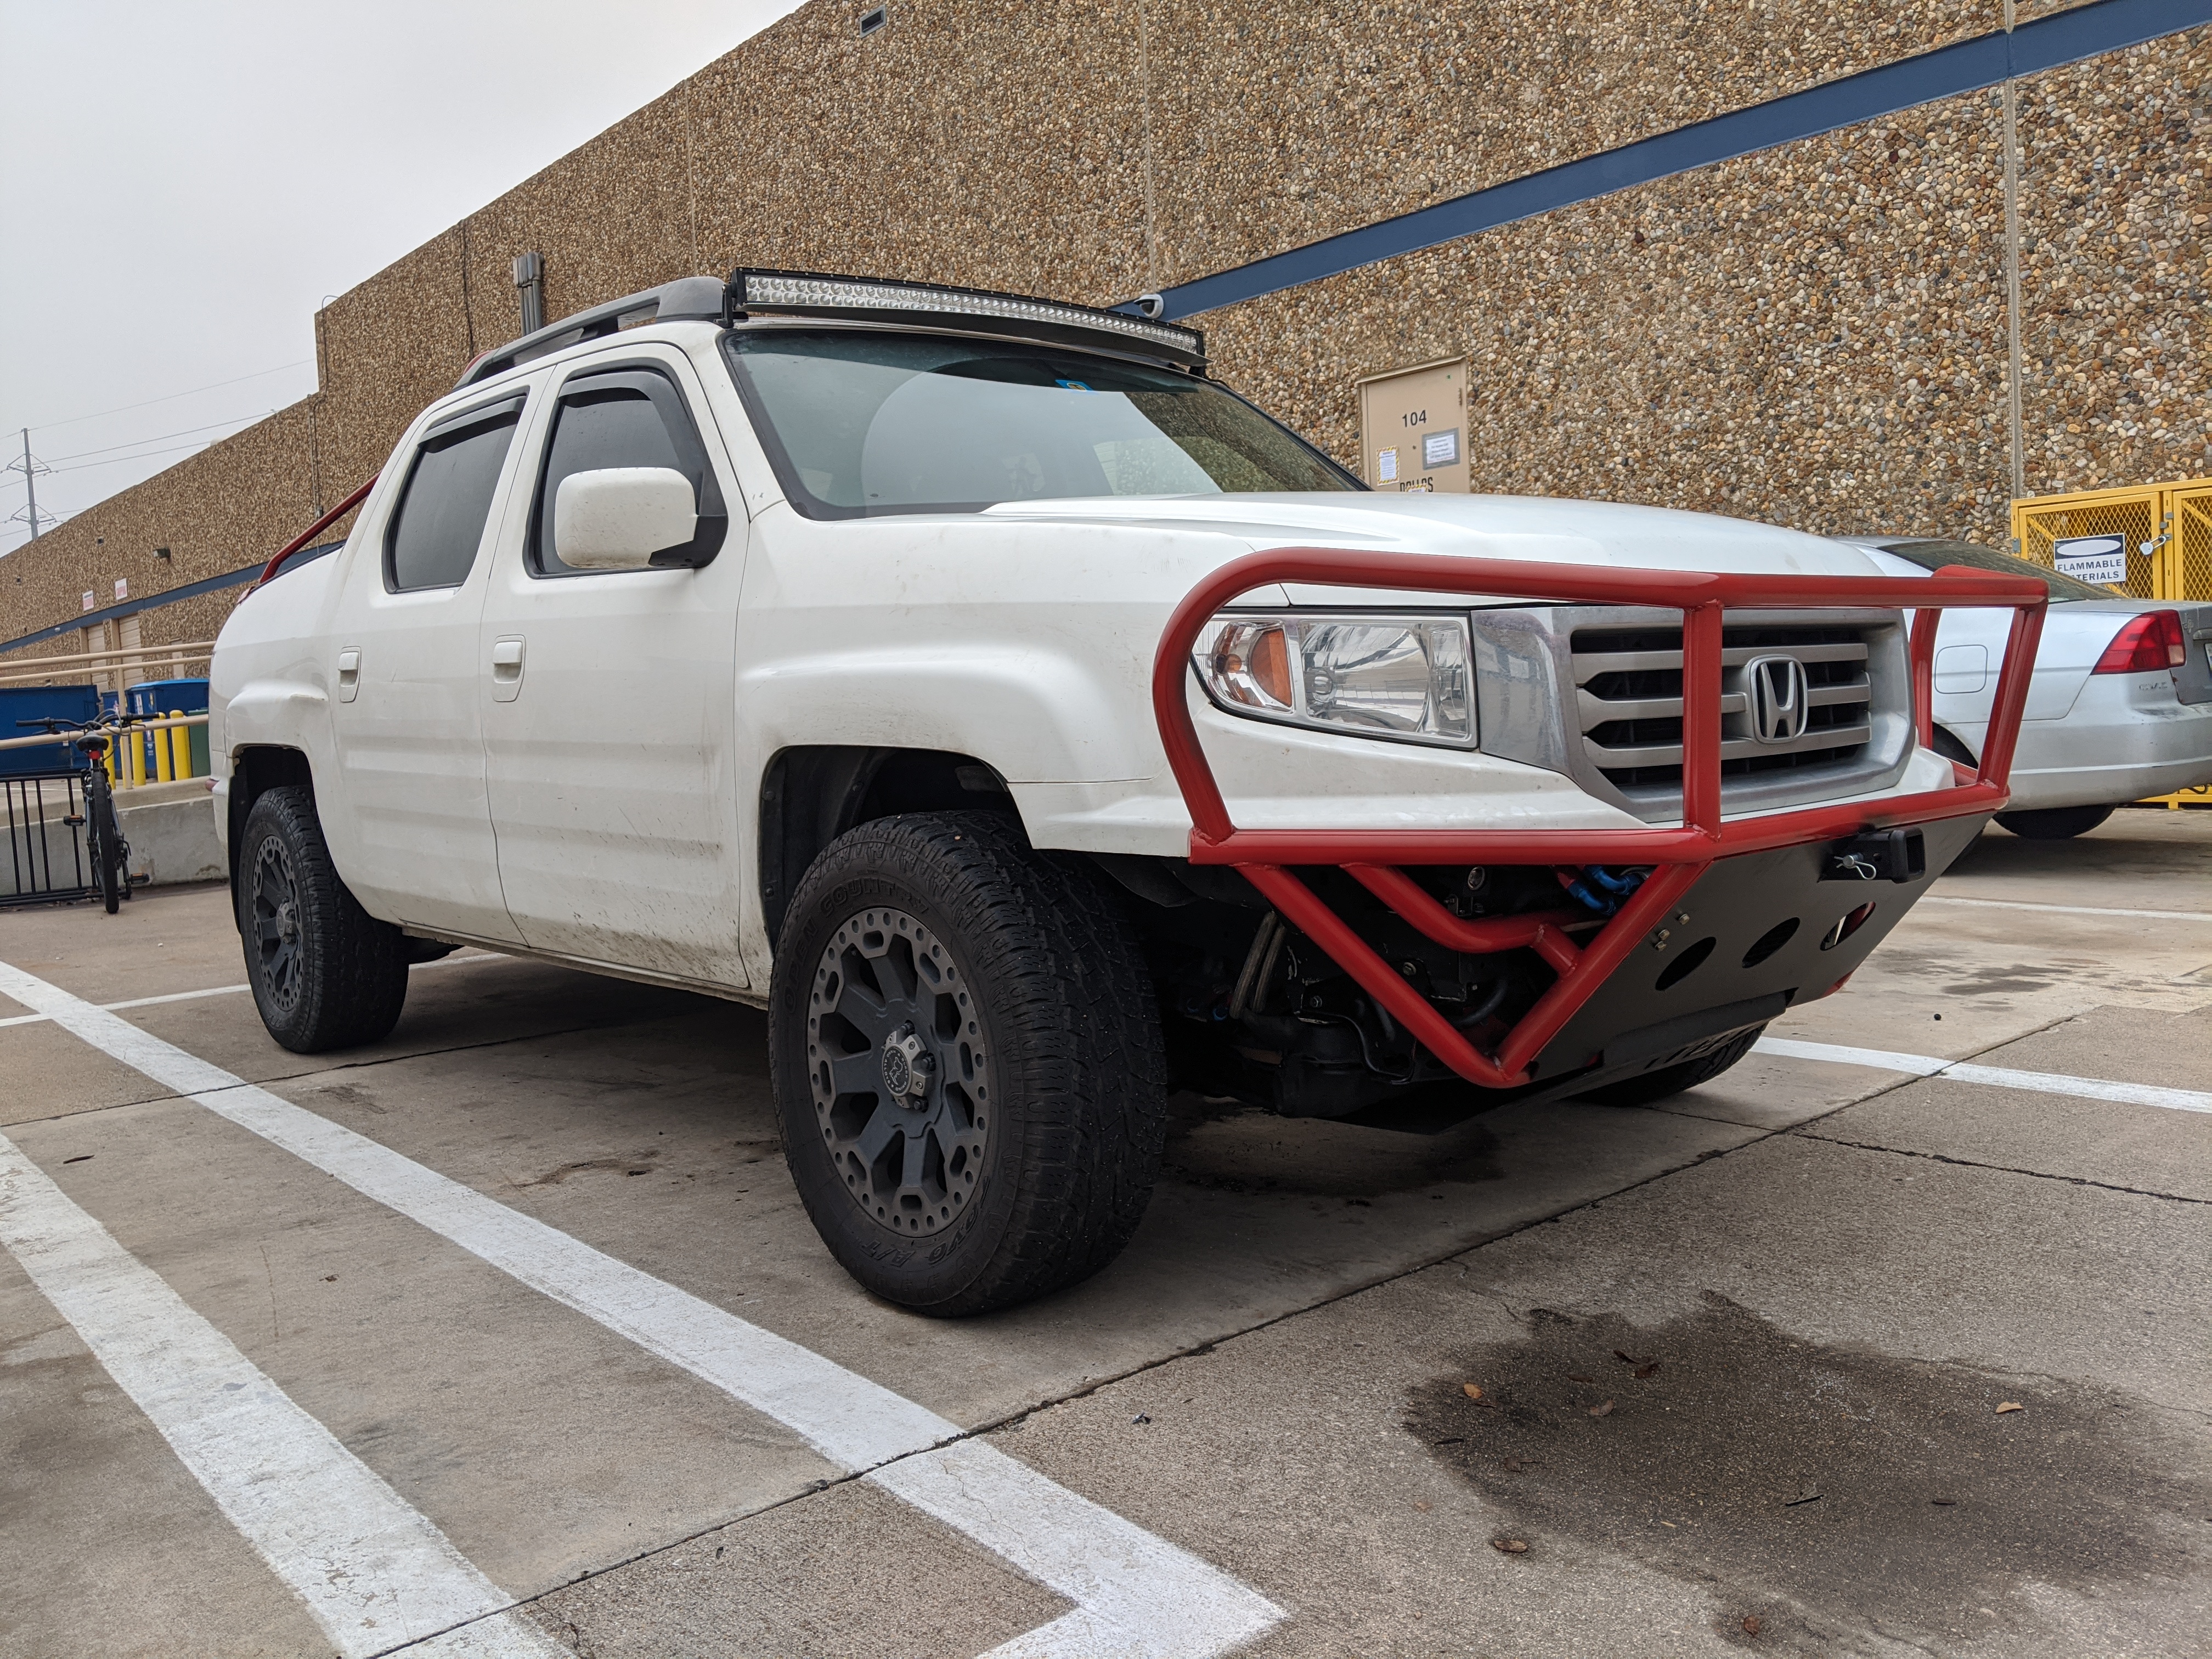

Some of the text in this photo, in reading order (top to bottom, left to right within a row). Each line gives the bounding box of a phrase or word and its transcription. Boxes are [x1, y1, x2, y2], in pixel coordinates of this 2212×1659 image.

[1402, 410, 1427, 427] 104
[2057, 559, 2122, 572] FLAMMABLE
[2072, 571, 2119, 581] TERIALS
[785, 916, 818, 1013] OPEN
[860, 1239, 916, 1268] A/T
